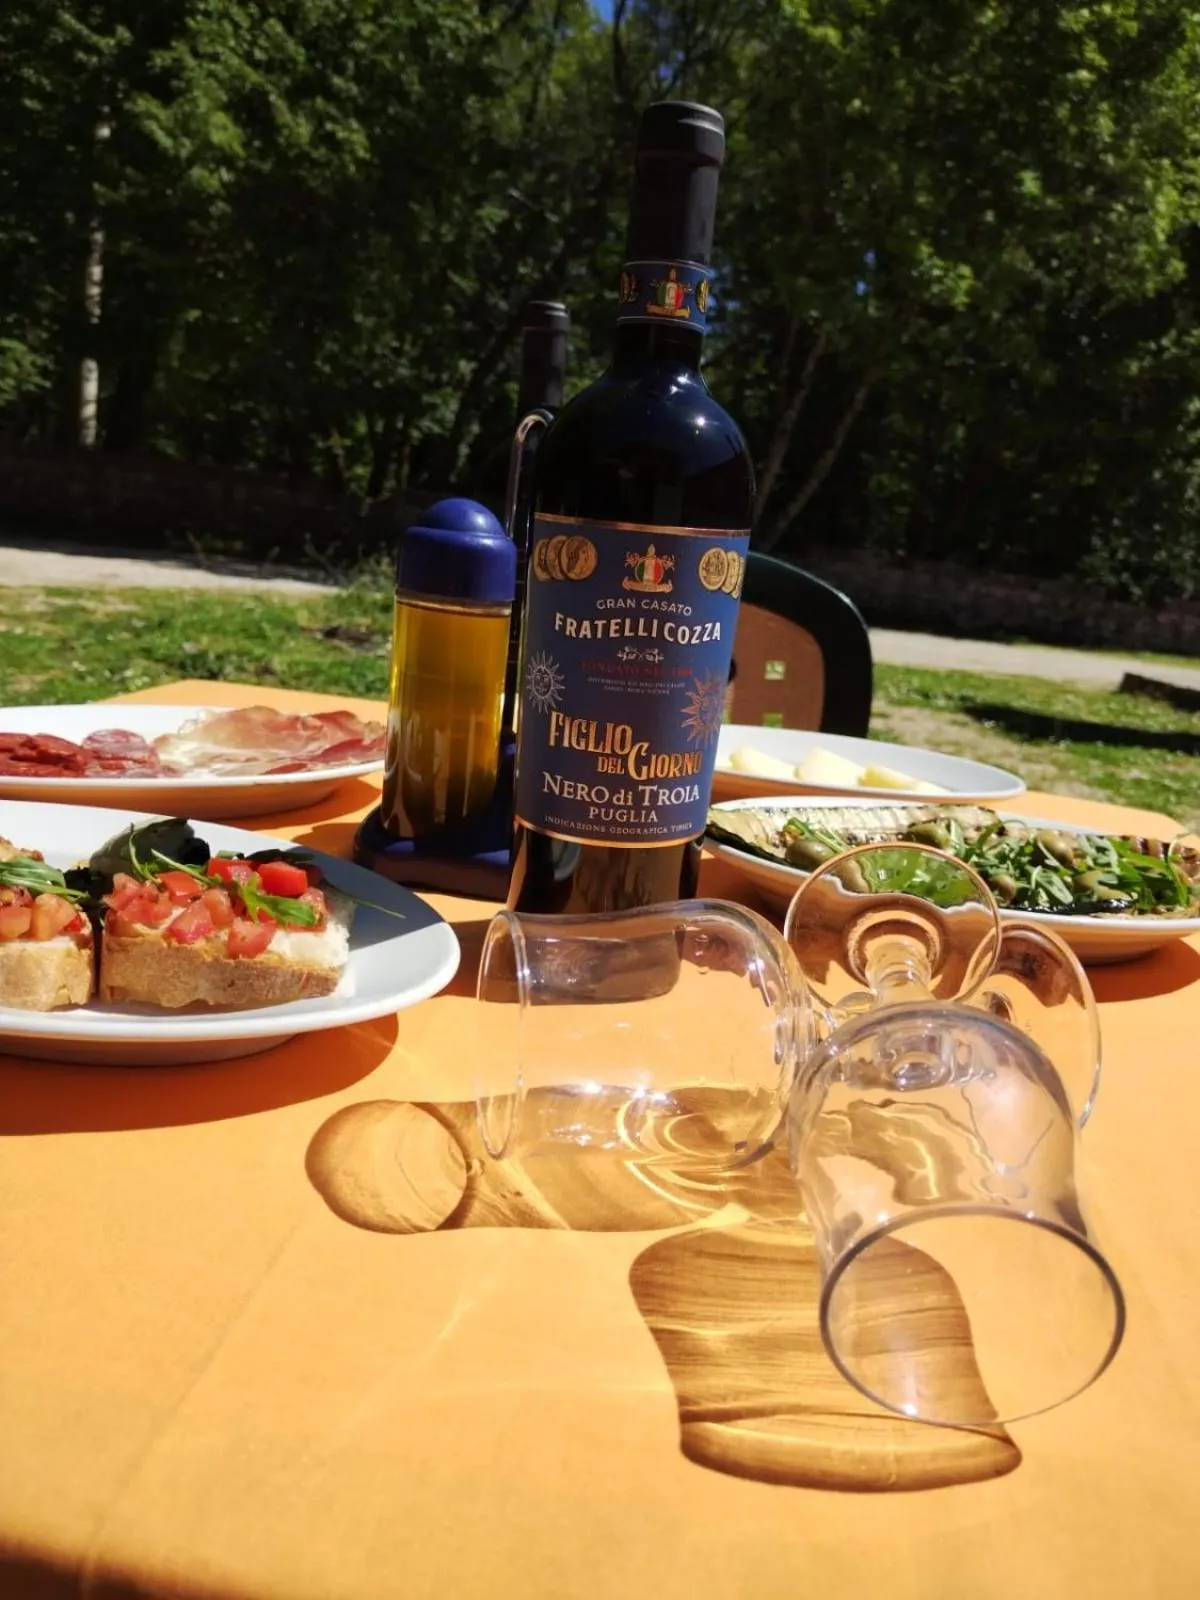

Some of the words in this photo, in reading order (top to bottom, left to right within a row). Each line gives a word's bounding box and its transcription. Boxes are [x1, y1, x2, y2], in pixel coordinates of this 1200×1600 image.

[596, 597, 636, 610] GRAN
[641, 599, 692, 617] CASATO
[554, 612, 658, 640] FRATELLI
[663, 622, 721, 645] COZZA
[549, 710, 634, 755] FIGLIO
[597, 756, 625, 775] DEL
[627, 741, 704, 781] GIORNO
[542, 771, 610, 804] NERO
[612, 789, 634, 806] di
[638, 783, 700, 806] TROIA
[544, 815, 606, 833] INDICAZIONE
[588, 806, 659, 823] PUGLIA
